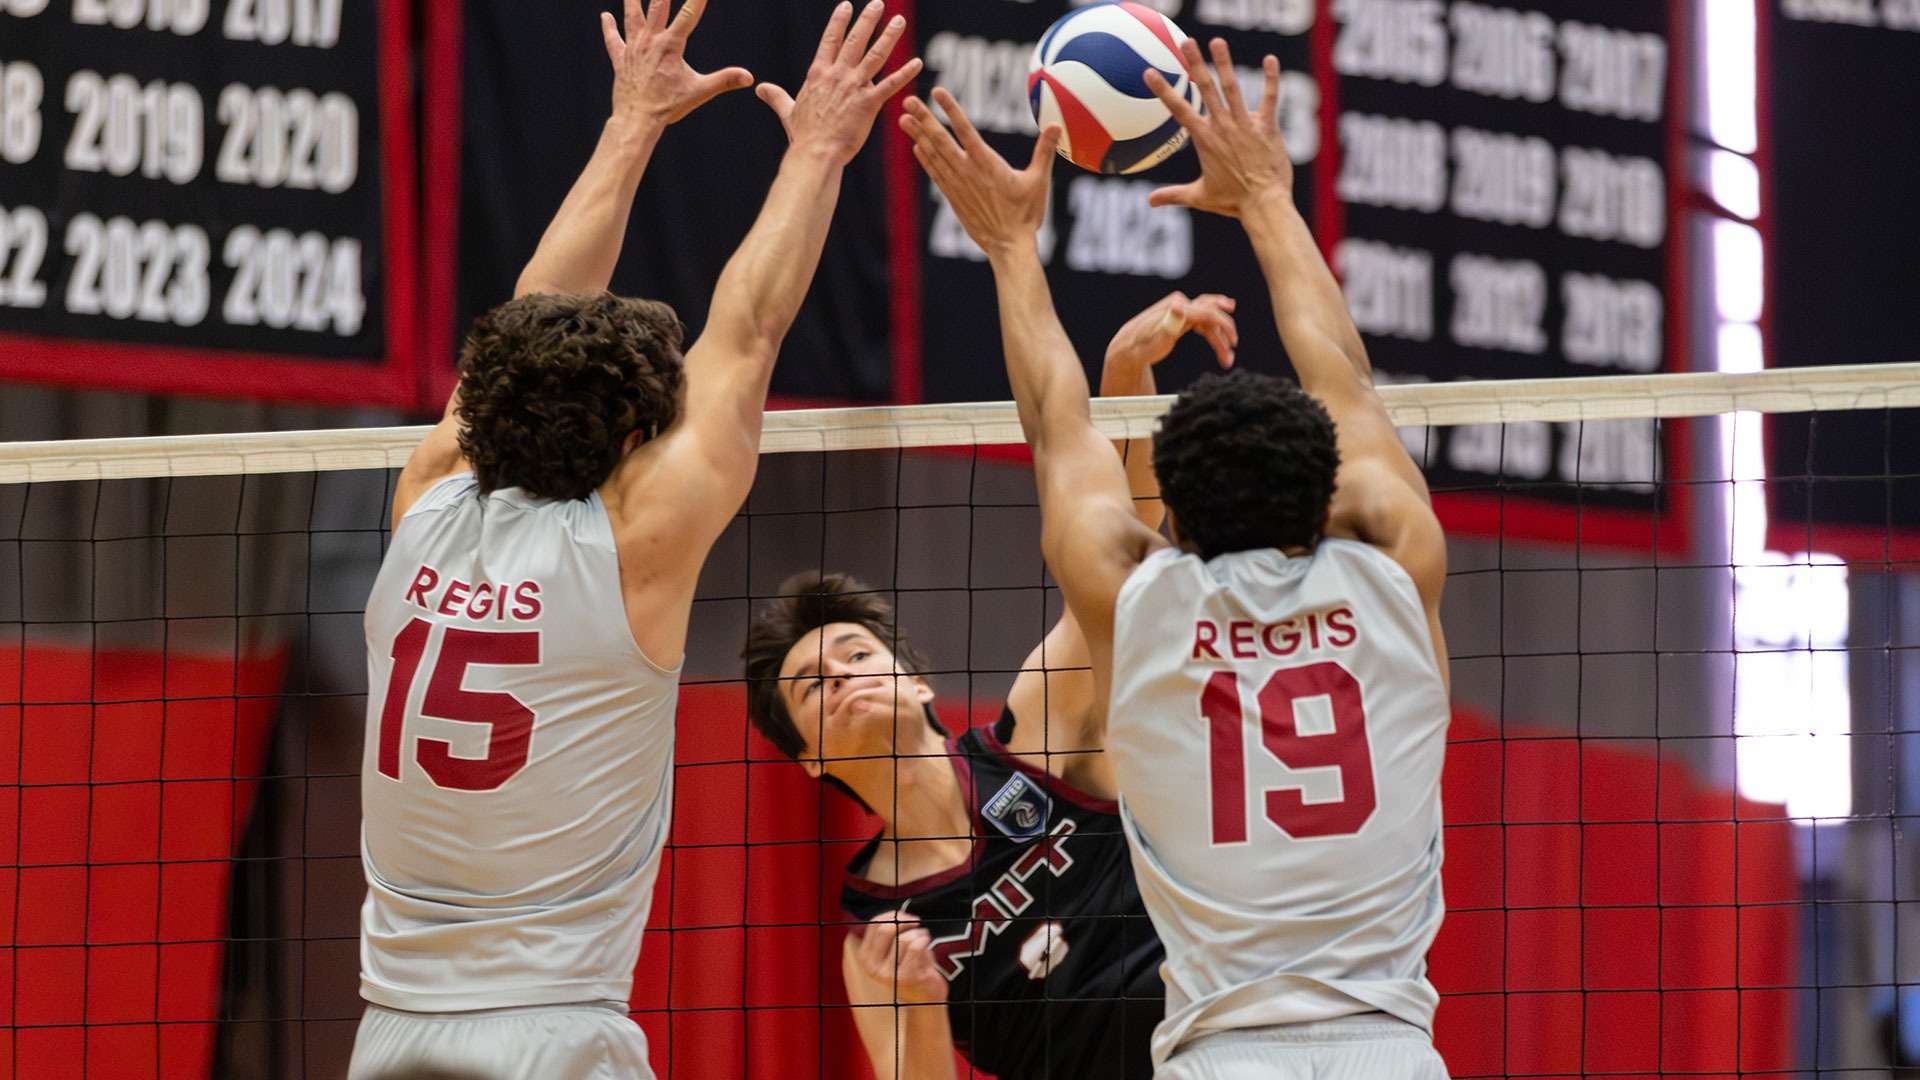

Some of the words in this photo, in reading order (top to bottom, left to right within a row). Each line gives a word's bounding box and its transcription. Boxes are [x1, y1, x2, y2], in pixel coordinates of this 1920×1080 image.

[64, 69, 205, 185] 2019
[215, 82, 359, 194] 2020
[64, 212, 211, 327] 2023
[222, 223, 366, 337] 2024
[404, 564, 544, 623] REGIS
[1190, 606, 1360, 663] REGIS
[375, 614, 544, 794] 15
[1198, 659, 1382, 848] 19
[989, 779, 1025, 818] UNITED
[927, 817, 1078, 982] MIT
